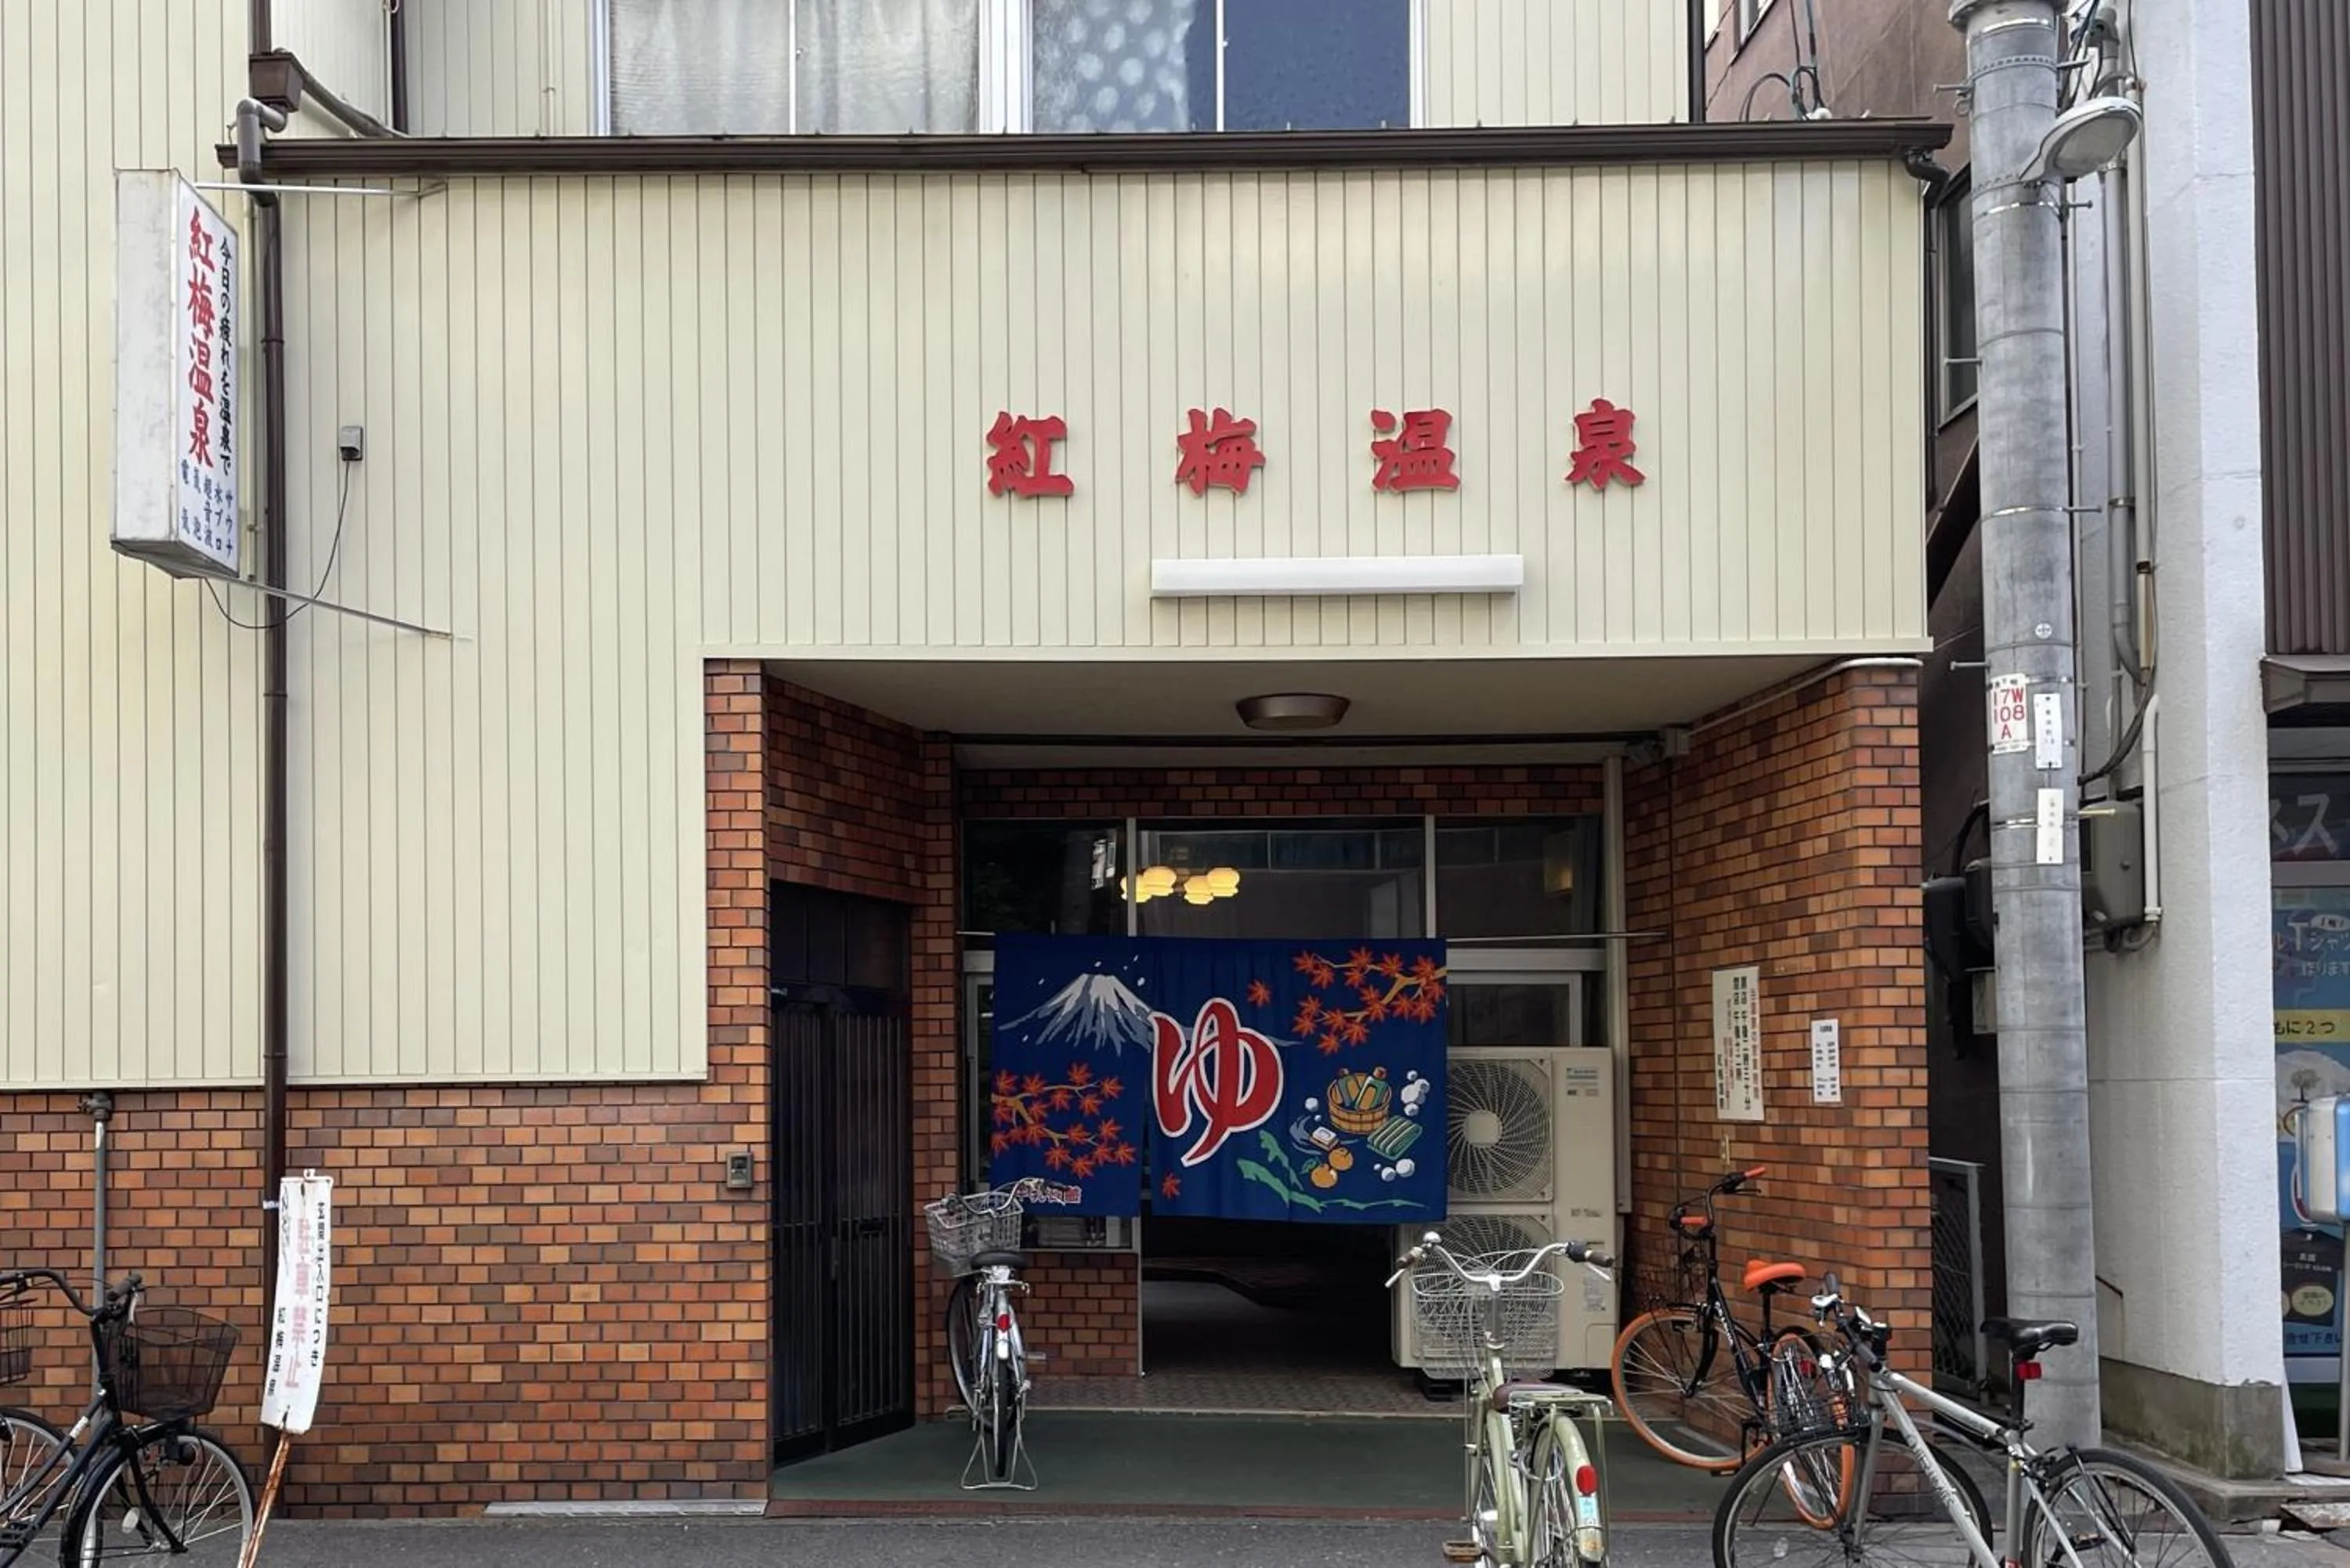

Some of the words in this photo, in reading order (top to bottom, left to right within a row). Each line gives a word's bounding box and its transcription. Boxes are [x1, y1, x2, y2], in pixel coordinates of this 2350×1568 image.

[188, 205, 215, 468] 紅梅温泉
[986, 398, 1645, 499] 紅梅温泉
[225, 489, 233, 558] サウナ
[1151, 997, 1284, 1167] ゆ
